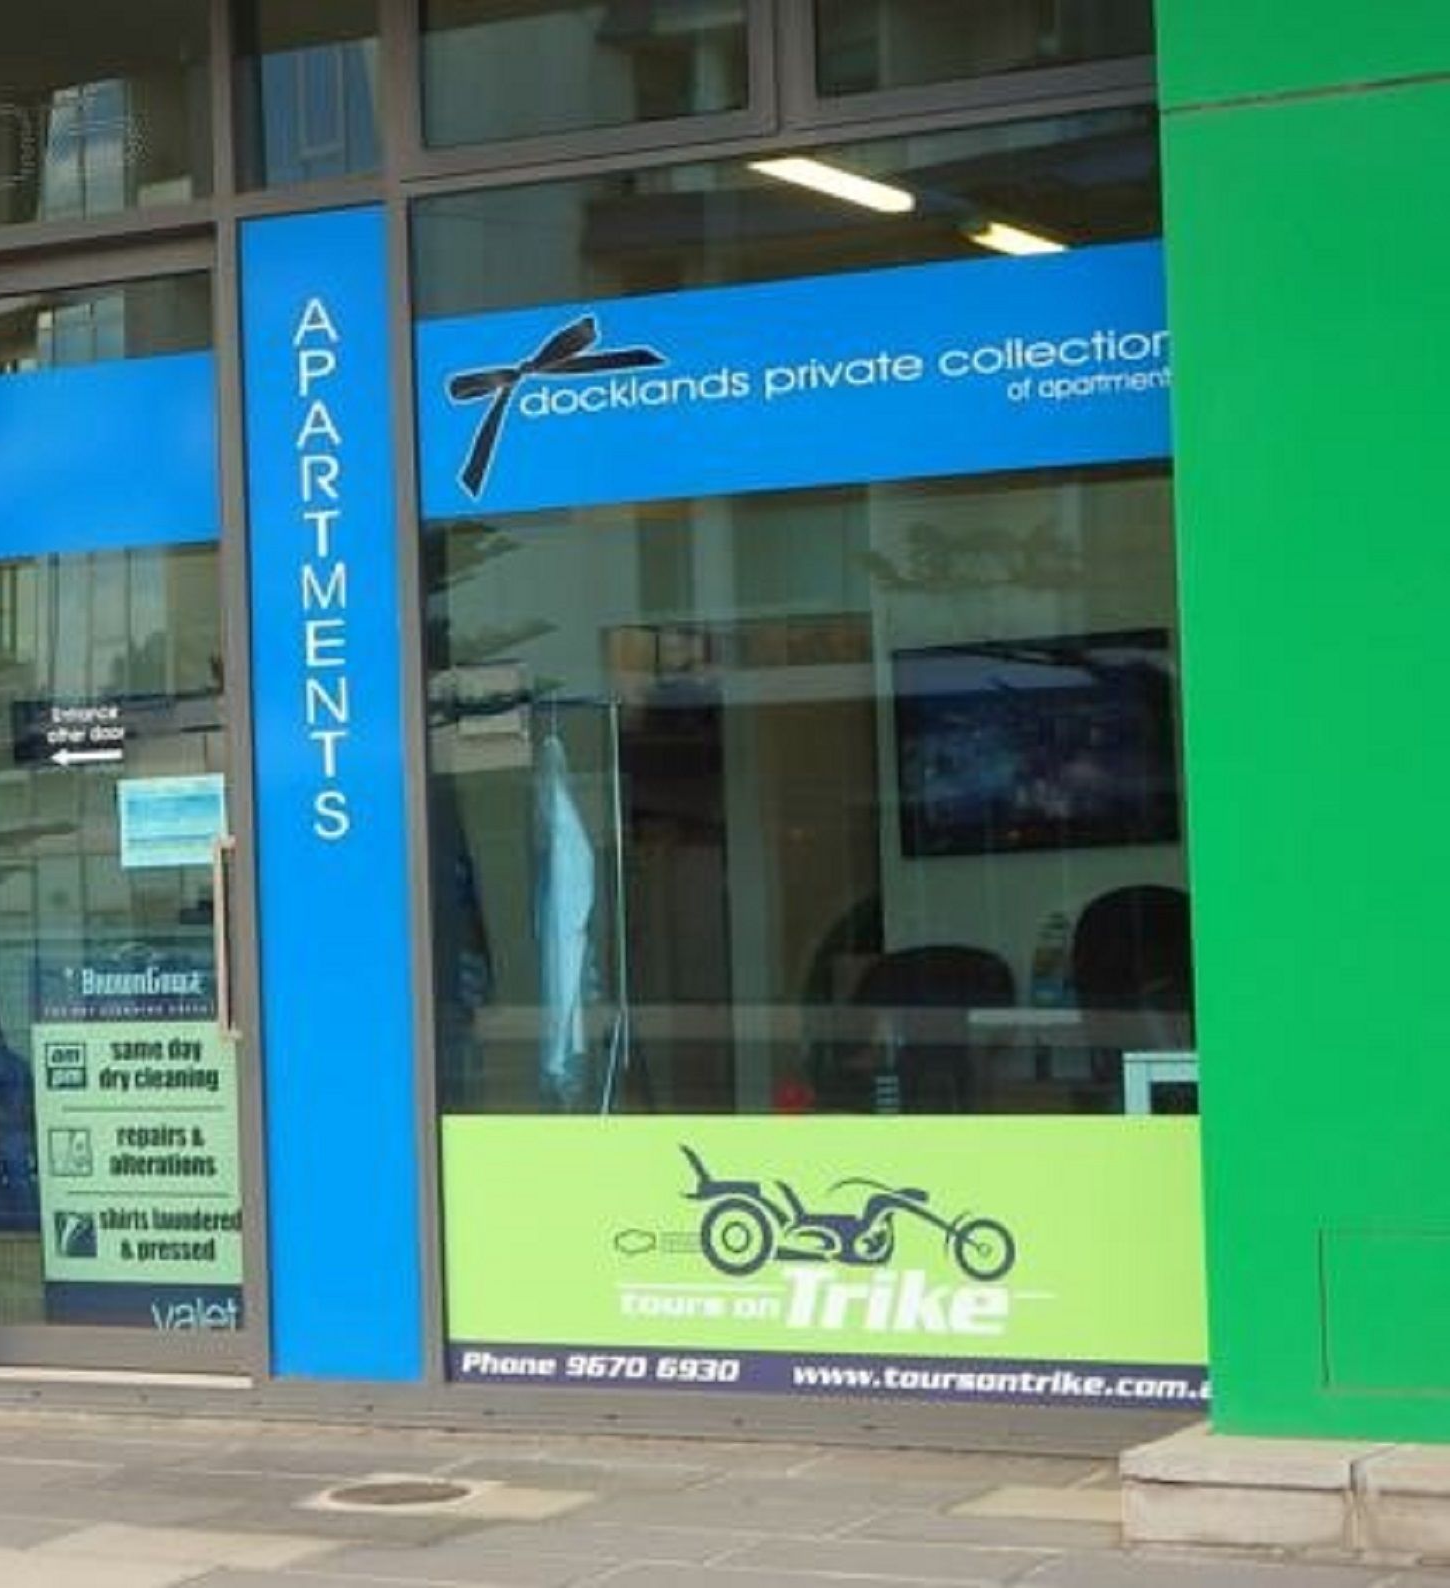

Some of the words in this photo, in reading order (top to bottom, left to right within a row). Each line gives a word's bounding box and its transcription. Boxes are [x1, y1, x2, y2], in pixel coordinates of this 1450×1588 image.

[520, 366, 749, 417] docklands
[765, 351, 923, 401] private
[1007, 378, 1031, 400] of
[293, 299, 349, 840] APARTMENTS
[110, 1042, 163, 1062] same
[168, 1038, 203, 1063] day
[99, 1066, 130, 1092] dry
[134, 1066, 221, 1092] cleaning
[116, 1124, 187, 1149] repairs
[192, 1128, 206, 1147] &
[109, 1154, 218, 1177] alterations
[99, 1208, 149, 1231] shirts
[152, 1207, 244, 1232] laundered
[121, 1239, 134, 1260] &
[137, 1237, 216, 1262] pressed
[619, 1293, 724, 1318] tours
[731, 1295, 781, 1319] on
[783, 1264, 1009, 1337] Trike
[151, 1297, 239, 1330] valet
[461, 1350, 557, 1377] Phone
[565, 1354, 648, 1379] 9670
[655, 1357, 740, 1383] 6930
